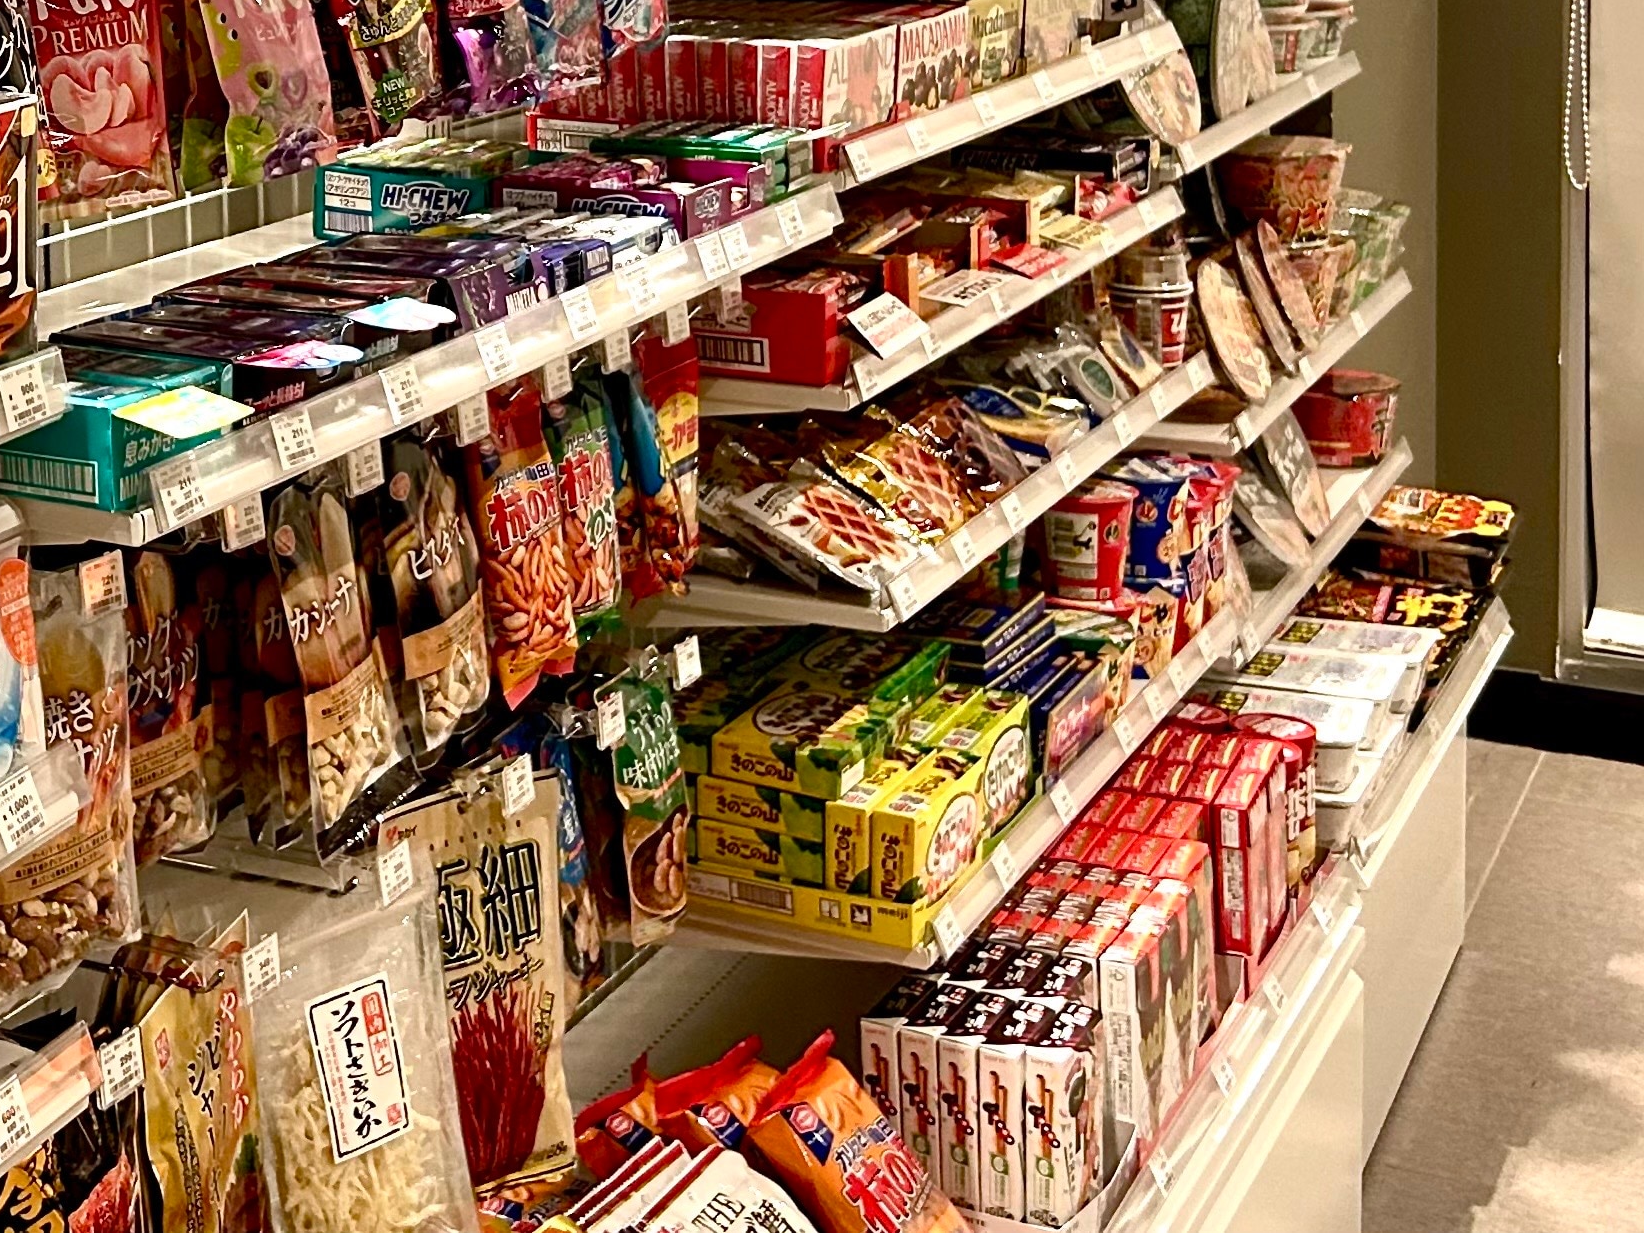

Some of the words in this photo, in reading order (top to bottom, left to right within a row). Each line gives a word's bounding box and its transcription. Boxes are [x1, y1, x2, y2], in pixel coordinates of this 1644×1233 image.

[33, 4, 148, 55] PREMIUM
[902, 17, 968, 60] MACADAMIA
[972, 9, 1019, 38] Macadamia
[828, 34, 895, 87] ALMOND
[382, 79, 406, 93] NEW
[381, 183, 470, 214] HI-CHEW
[731, 751, 794, 784] きのこの山
[9, 795, 29, 816] 1,000
[716, 793, 780, 824] きのこの山
[716, 839, 780, 868] きのこの山
[876, 905, 909, 920] meiji
[362, 991, 394, 1077] 国内加工
[219, 987, 250, 1128] やわらか
[331, 998, 383, 1139] ソフトさきいか
[692, 1192, 747, 1233] THE
